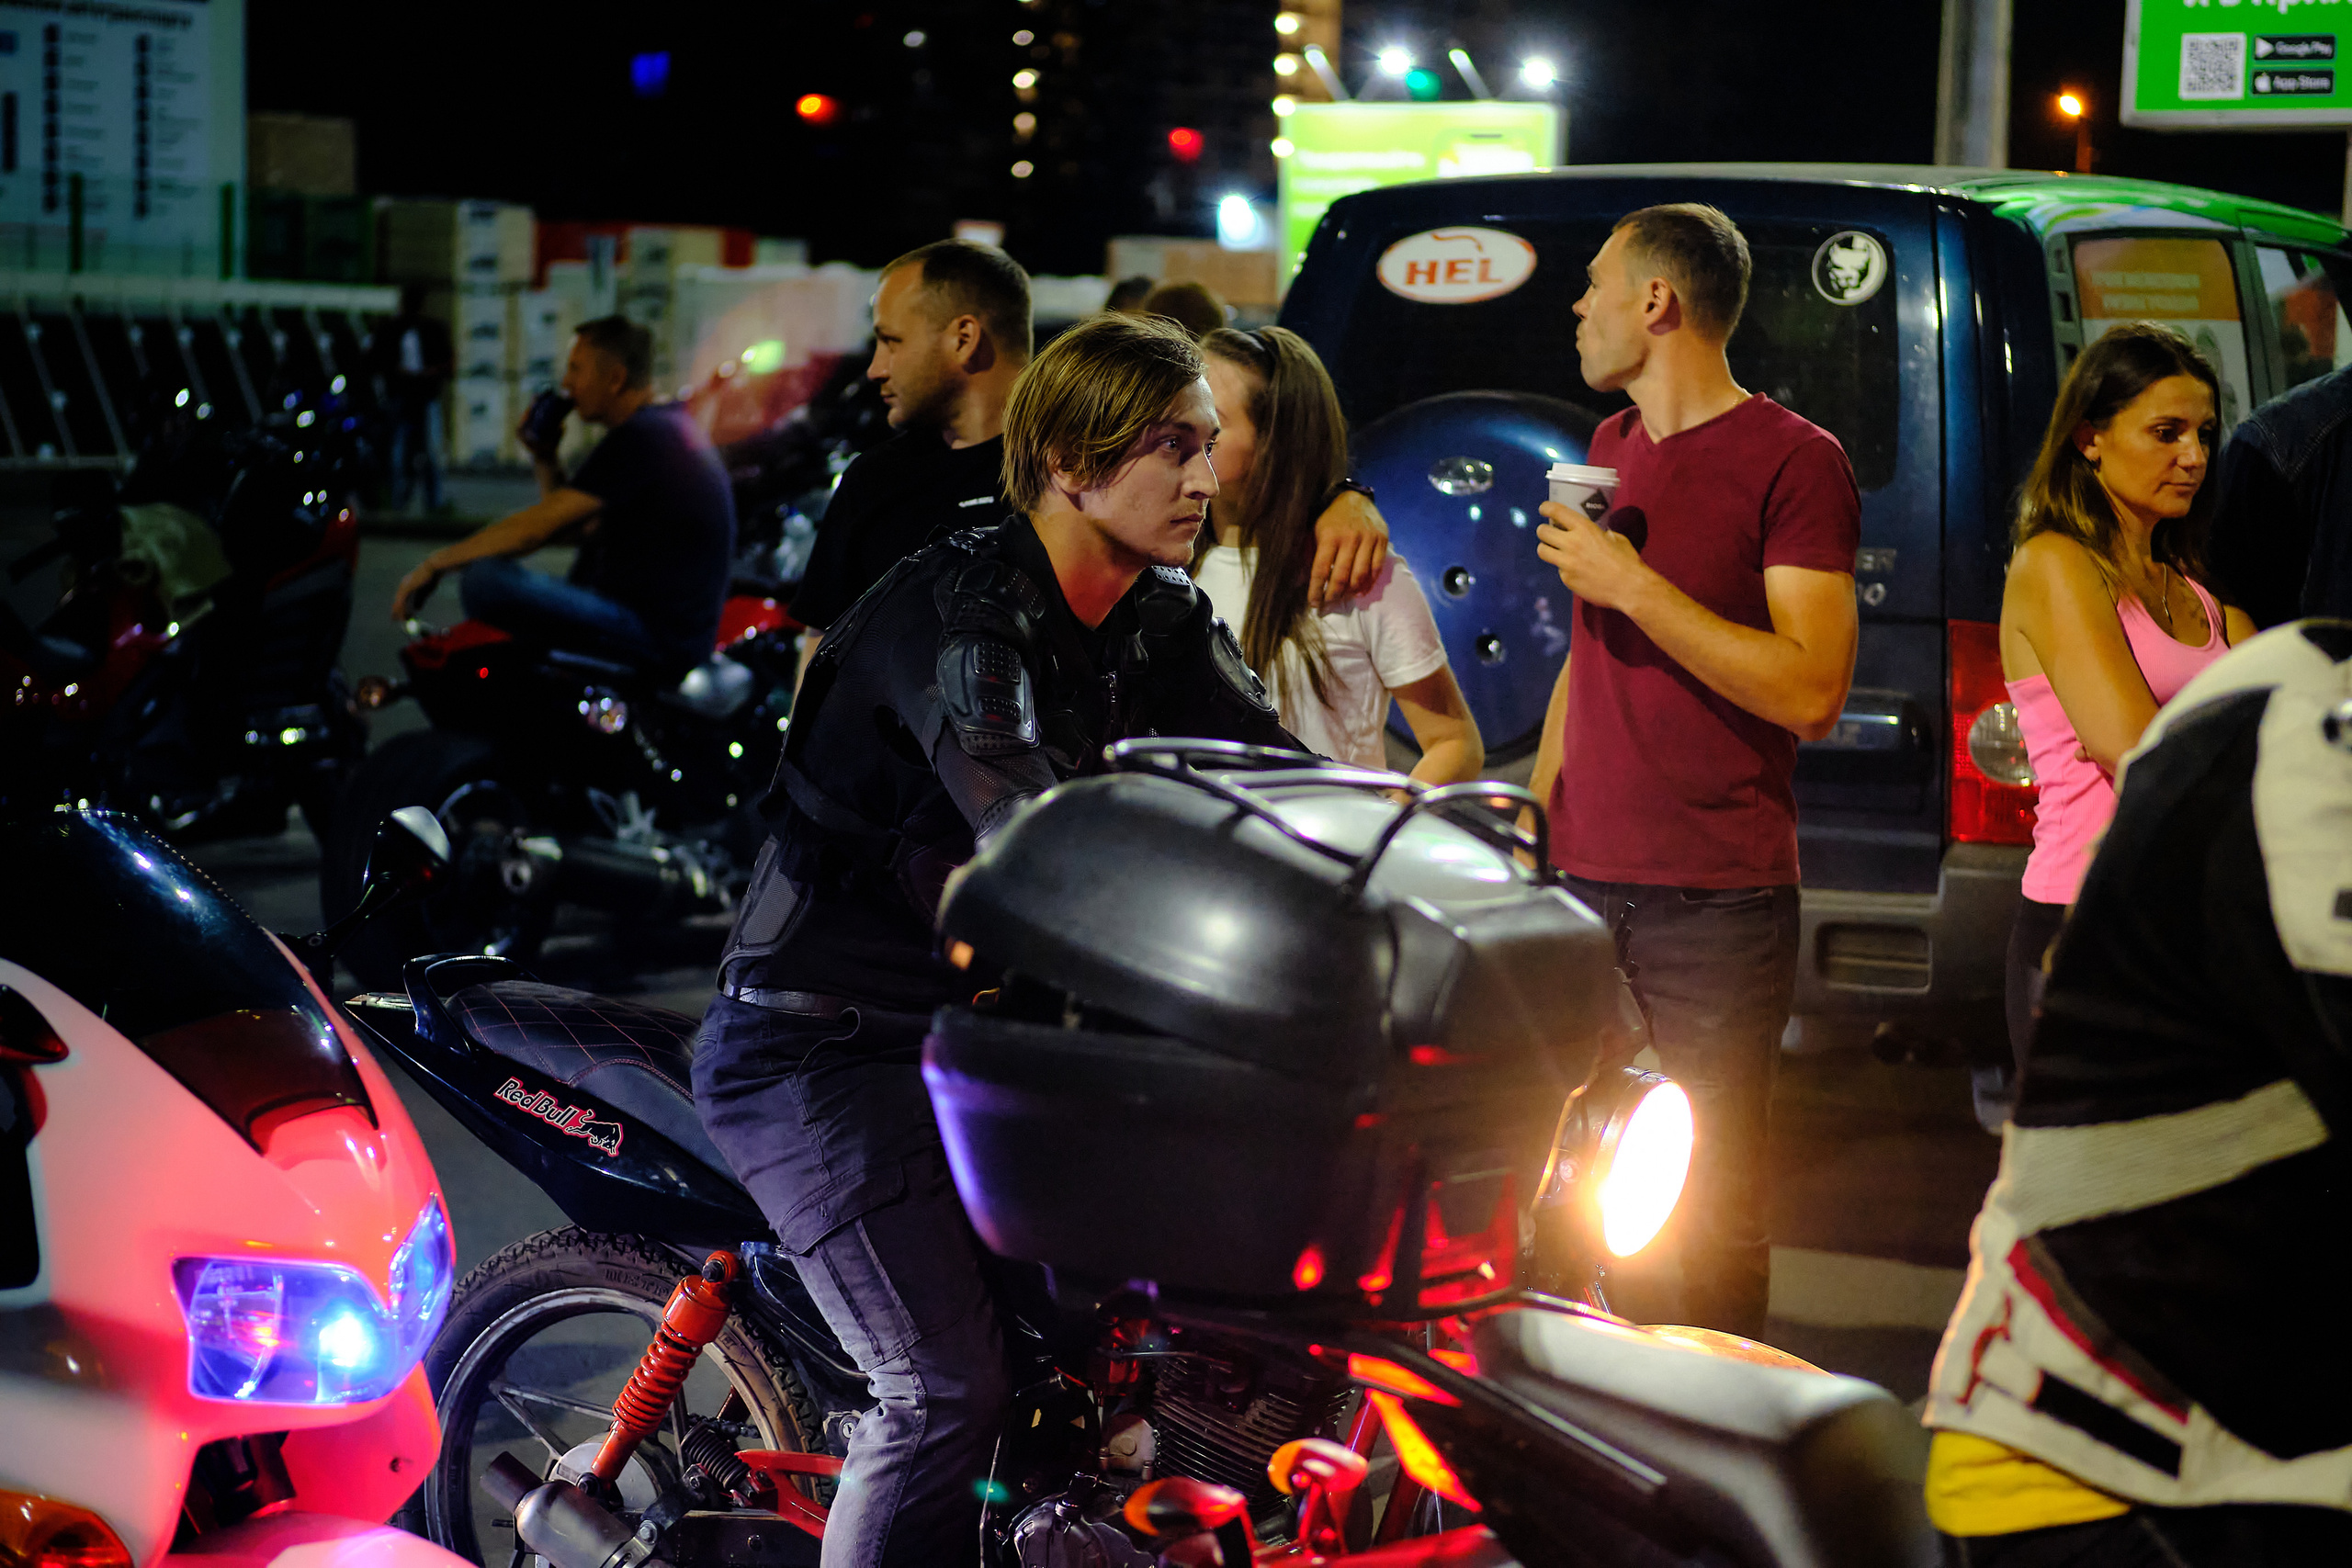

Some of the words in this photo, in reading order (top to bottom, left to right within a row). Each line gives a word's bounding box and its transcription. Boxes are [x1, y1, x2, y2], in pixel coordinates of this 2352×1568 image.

[2276, 40, 2310, 57] Google
[2274, 75, 2298, 90] App
[2299, 74, 2331, 90] Store
[1405, 258, 1503, 285] HEL
